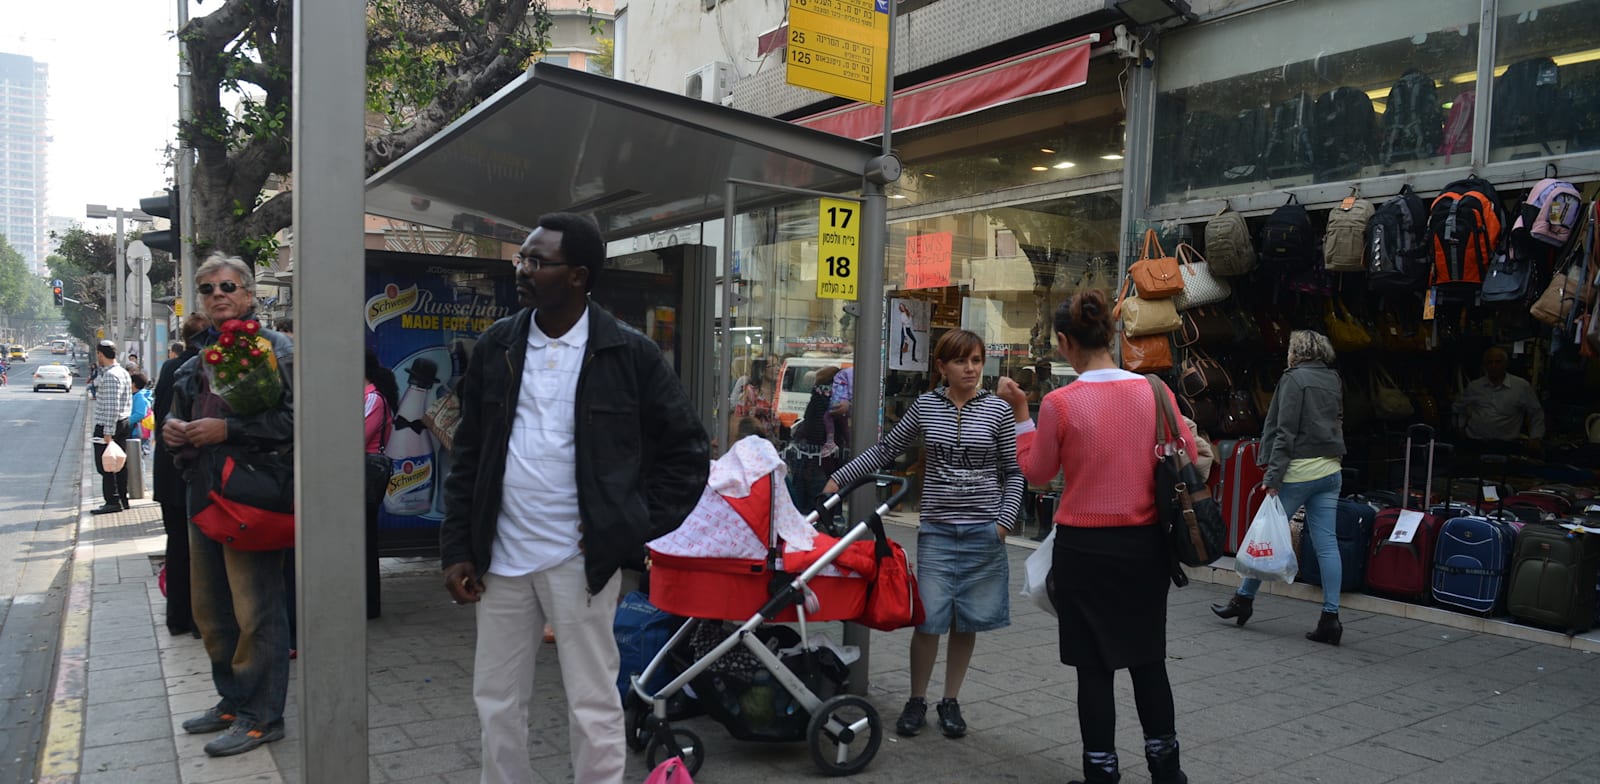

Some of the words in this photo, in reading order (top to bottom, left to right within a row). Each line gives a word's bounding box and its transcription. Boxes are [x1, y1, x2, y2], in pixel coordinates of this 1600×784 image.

[792, 31, 805, 44] 25
[792, 50, 811, 64] 125
[827, 207, 853, 229] 17
[826, 256, 850, 278] 18
[821, 280, 839, 295] העלמין
[410, 288, 510, 318] Russchian
[402, 314, 439, 330] MADE
[443, 316, 466, 331] FOR
